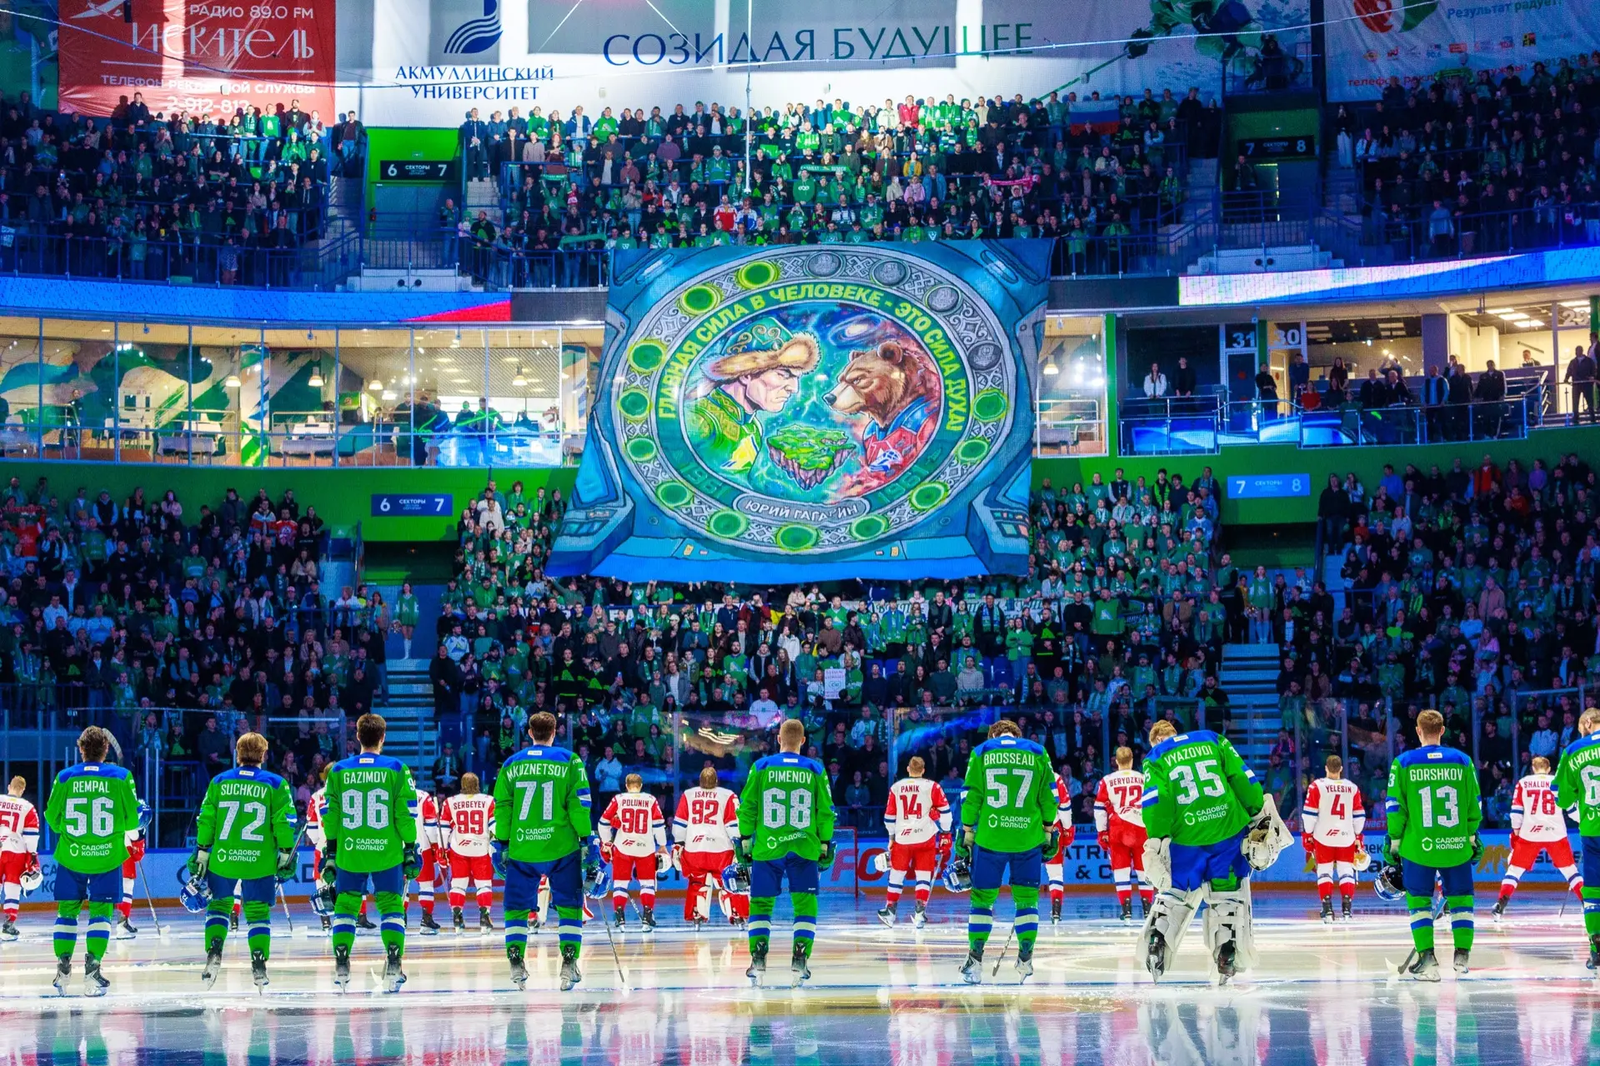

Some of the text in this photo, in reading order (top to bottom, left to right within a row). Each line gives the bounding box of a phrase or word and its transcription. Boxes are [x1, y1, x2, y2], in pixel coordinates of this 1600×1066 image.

[190, 5, 314, 19] РАДИО 89.0 FM
[1447, 2, 1512, 18] Результат
[602, 22, 1033, 67] СОЗИДАЯ БУДУЩЕЕ
[395, 65, 554, 81] АКМУЛЛИНСКИЙ
[101, 75, 163, 88] ТЕЛЕФОН
[255, 81, 316, 94] СЛУЖБЫ
[411, 86, 540, 100] УНИВЕРСИТЕТ
[1245, 142, 1255, 155] 7
[1296, 140, 1306, 152] 8
[387, 164, 398, 177] 6
[438, 164, 448, 177] 7
[1232, 331, 1255, 348] 31
[1273, 329, 1300, 346] 30
[658, 340, 702, 418] ГЛАВНАЯ
[696, 303, 750, 343] СИЛА
[750, 295, 766, 310] В
[769, 284, 884, 307] ЧЕЛОВЕКЕ
[894, 302, 932, 332] ЭТО
[928, 331, 961, 377] СИЛА
[1236, 480, 1246, 494] 7
[1292, 478, 1302, 492] 8
[380, 497, 391, 512] 6
[434, 498, 445, 512] 7
[745, 500, 791, 518] ЮРИЙ
[984, 753, 1035, 766] BROSSEAU
[1164, 745, 1213, 767] VYAZOVOI
[343, 771, 388, 784] GAZIMOV
[768, 770, 812, 784] PIMENOV
[1169, 759, 1225, 804] 35
[1409, 768, 1464, 782] GORSHKOV
[73, 780, 110, 793] REMPAL
[220, 783, 268, 799] SUCHKOV
[901, 785, 920, 794] PANIK
[986, 768, 1034, 809] 57
[1325, 785, 1352, 793] YELESIN
[1524, 781, 1549, 789] SHALUN
[515, 780, 554, 821] 71
[695, 791, 718, 799] ISAYEV
[1114, 785, 1142, 809] 72
[1526, 789, 1556, 815] 78
[341, 787, 389, 830] 96
[453, 801, 486, 810] SERGEYEV
[622, 799, 649, 808] POLUNIN
[763, 787, 812, 829] 68
[900, 794, 922, 820] 14
[1196, 803, 1229, 816] САДОВОЕ
[1331, 794, 1345, 820] 4
[1418, 785, 1460, 828] 13
[65, 796, 114, 837] 56
[692, 800, 719, 825] 92
[1000, 816, 1031, 824] САДОВОЕ
[1198, 811, 1226, 823] КОЛЬЦО
[218, 801, 267, 842] 72
[456, 810, 485, 835] 99
[621, 808, 649, 834] 90
[1000, 822, 1028, 830] КОЛЬЦО
[1363, 820, 1387, 828] NBET
[81, 843, 113, 851] САДОВОЕ
[81, 849, 110, 857] КОЛЬЦО
[228, 849, 261, 857] САДОВОЕ
[1076, 864, 1090, 879] &
